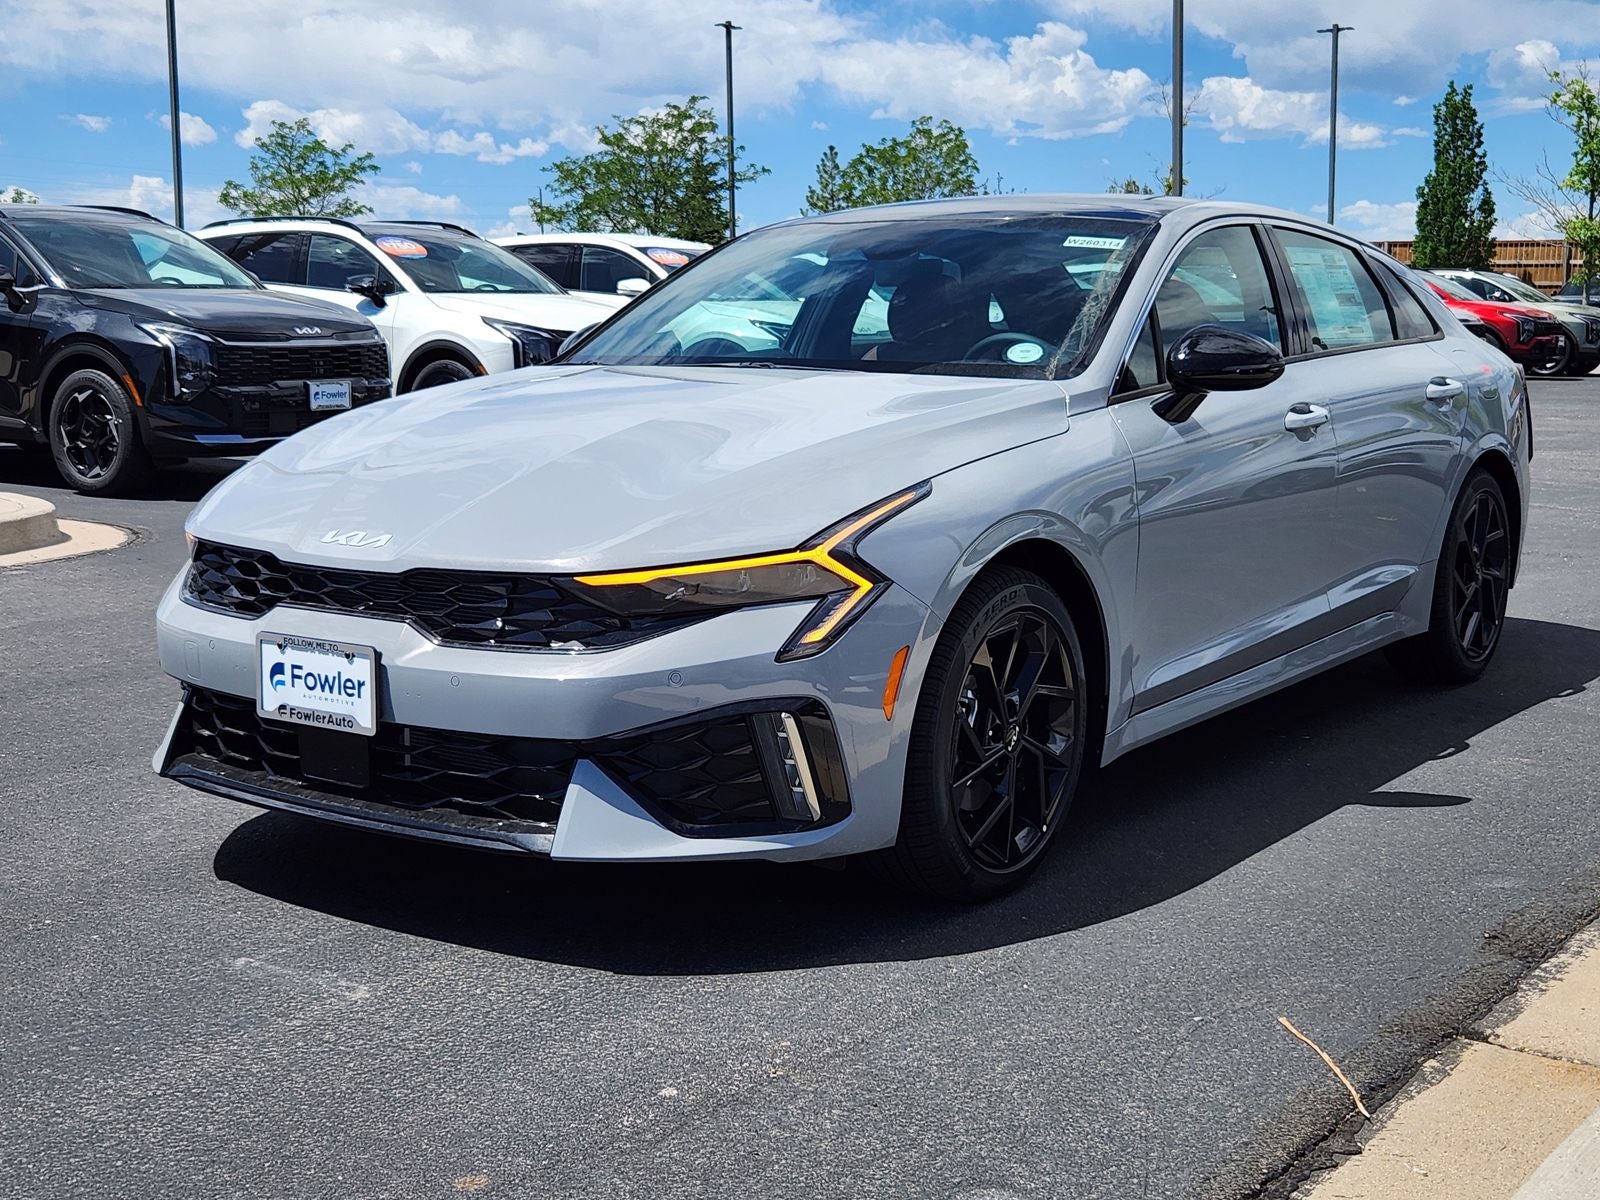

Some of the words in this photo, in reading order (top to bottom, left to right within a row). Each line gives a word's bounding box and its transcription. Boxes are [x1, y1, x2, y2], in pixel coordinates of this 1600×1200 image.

[1068, 238, 1121, 247] W260314
[321, 390, 347, 399] Fowler
[320, 528, 394, 548] KIA
[283, 637, 313, 649] FOLLOW
[316, 642, 327, 650] ME
[290, 664, 366, 699] Fowler
[303, 694, 355, 706] AUTOMOTIVE
[289, 707, 354, 729] FowlerAuto
